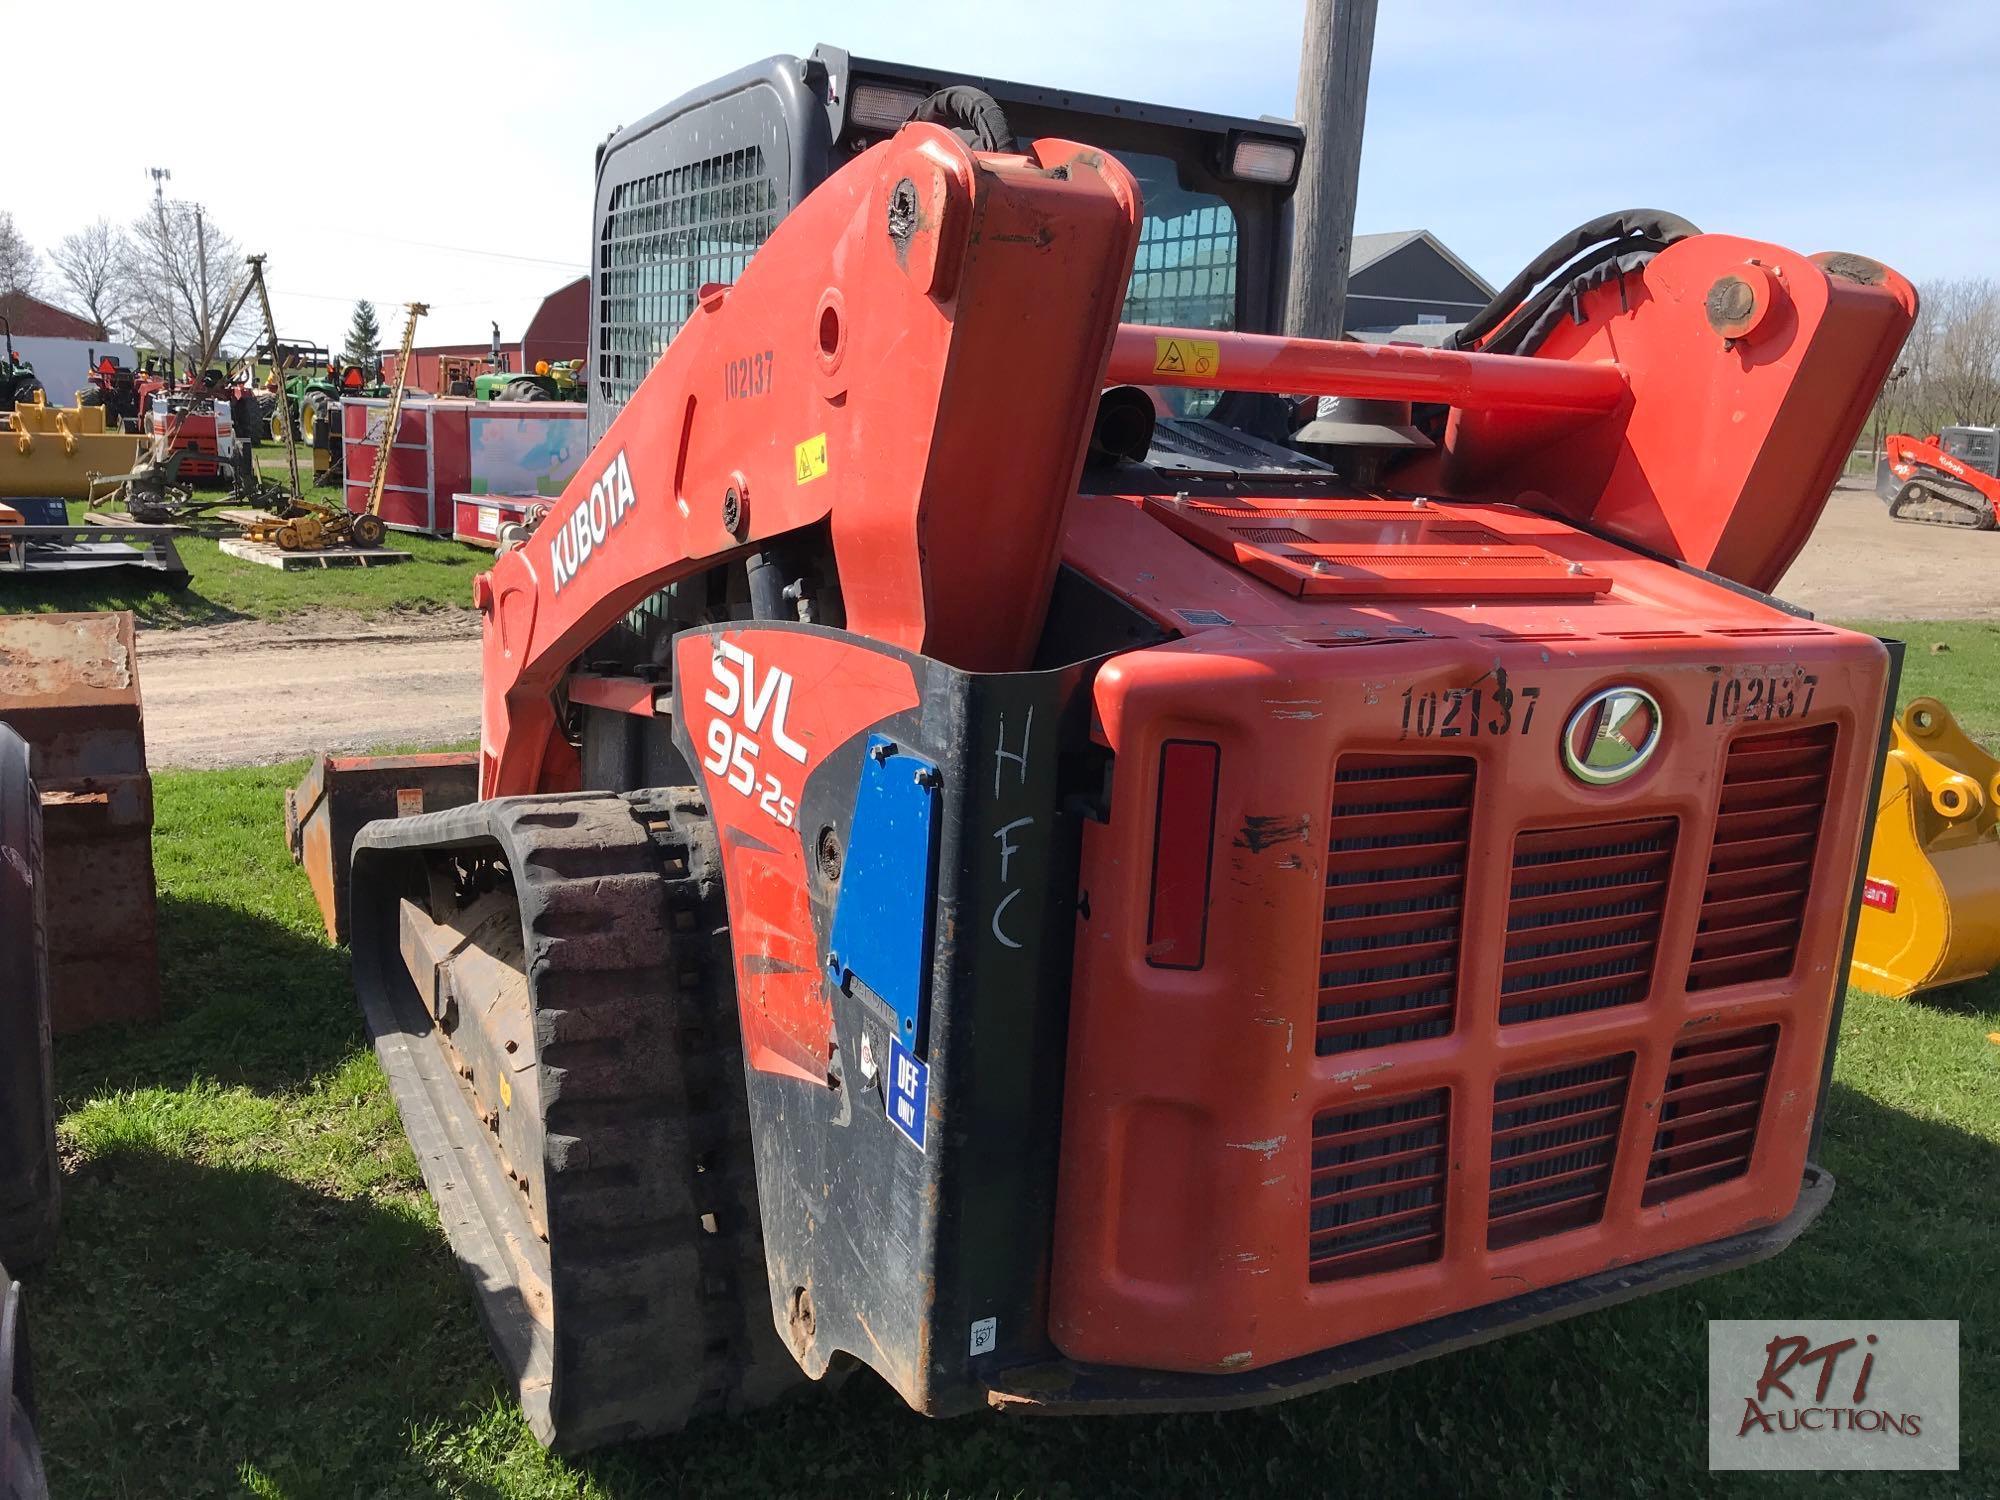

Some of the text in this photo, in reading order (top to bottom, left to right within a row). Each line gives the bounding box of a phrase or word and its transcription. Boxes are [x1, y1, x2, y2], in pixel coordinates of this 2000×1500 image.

[724, 351, 774, 402] 102137
[550, 449, 636, 593] KUBOTA
[704, 639, 808, 765] SVL
[1400, 685, 1541, 741] 102137
[1705, 674, 1819, 725] 102137
[897, 1053, 920, 1100] DEF
[897, 1095, 916, 1129] ONLY
